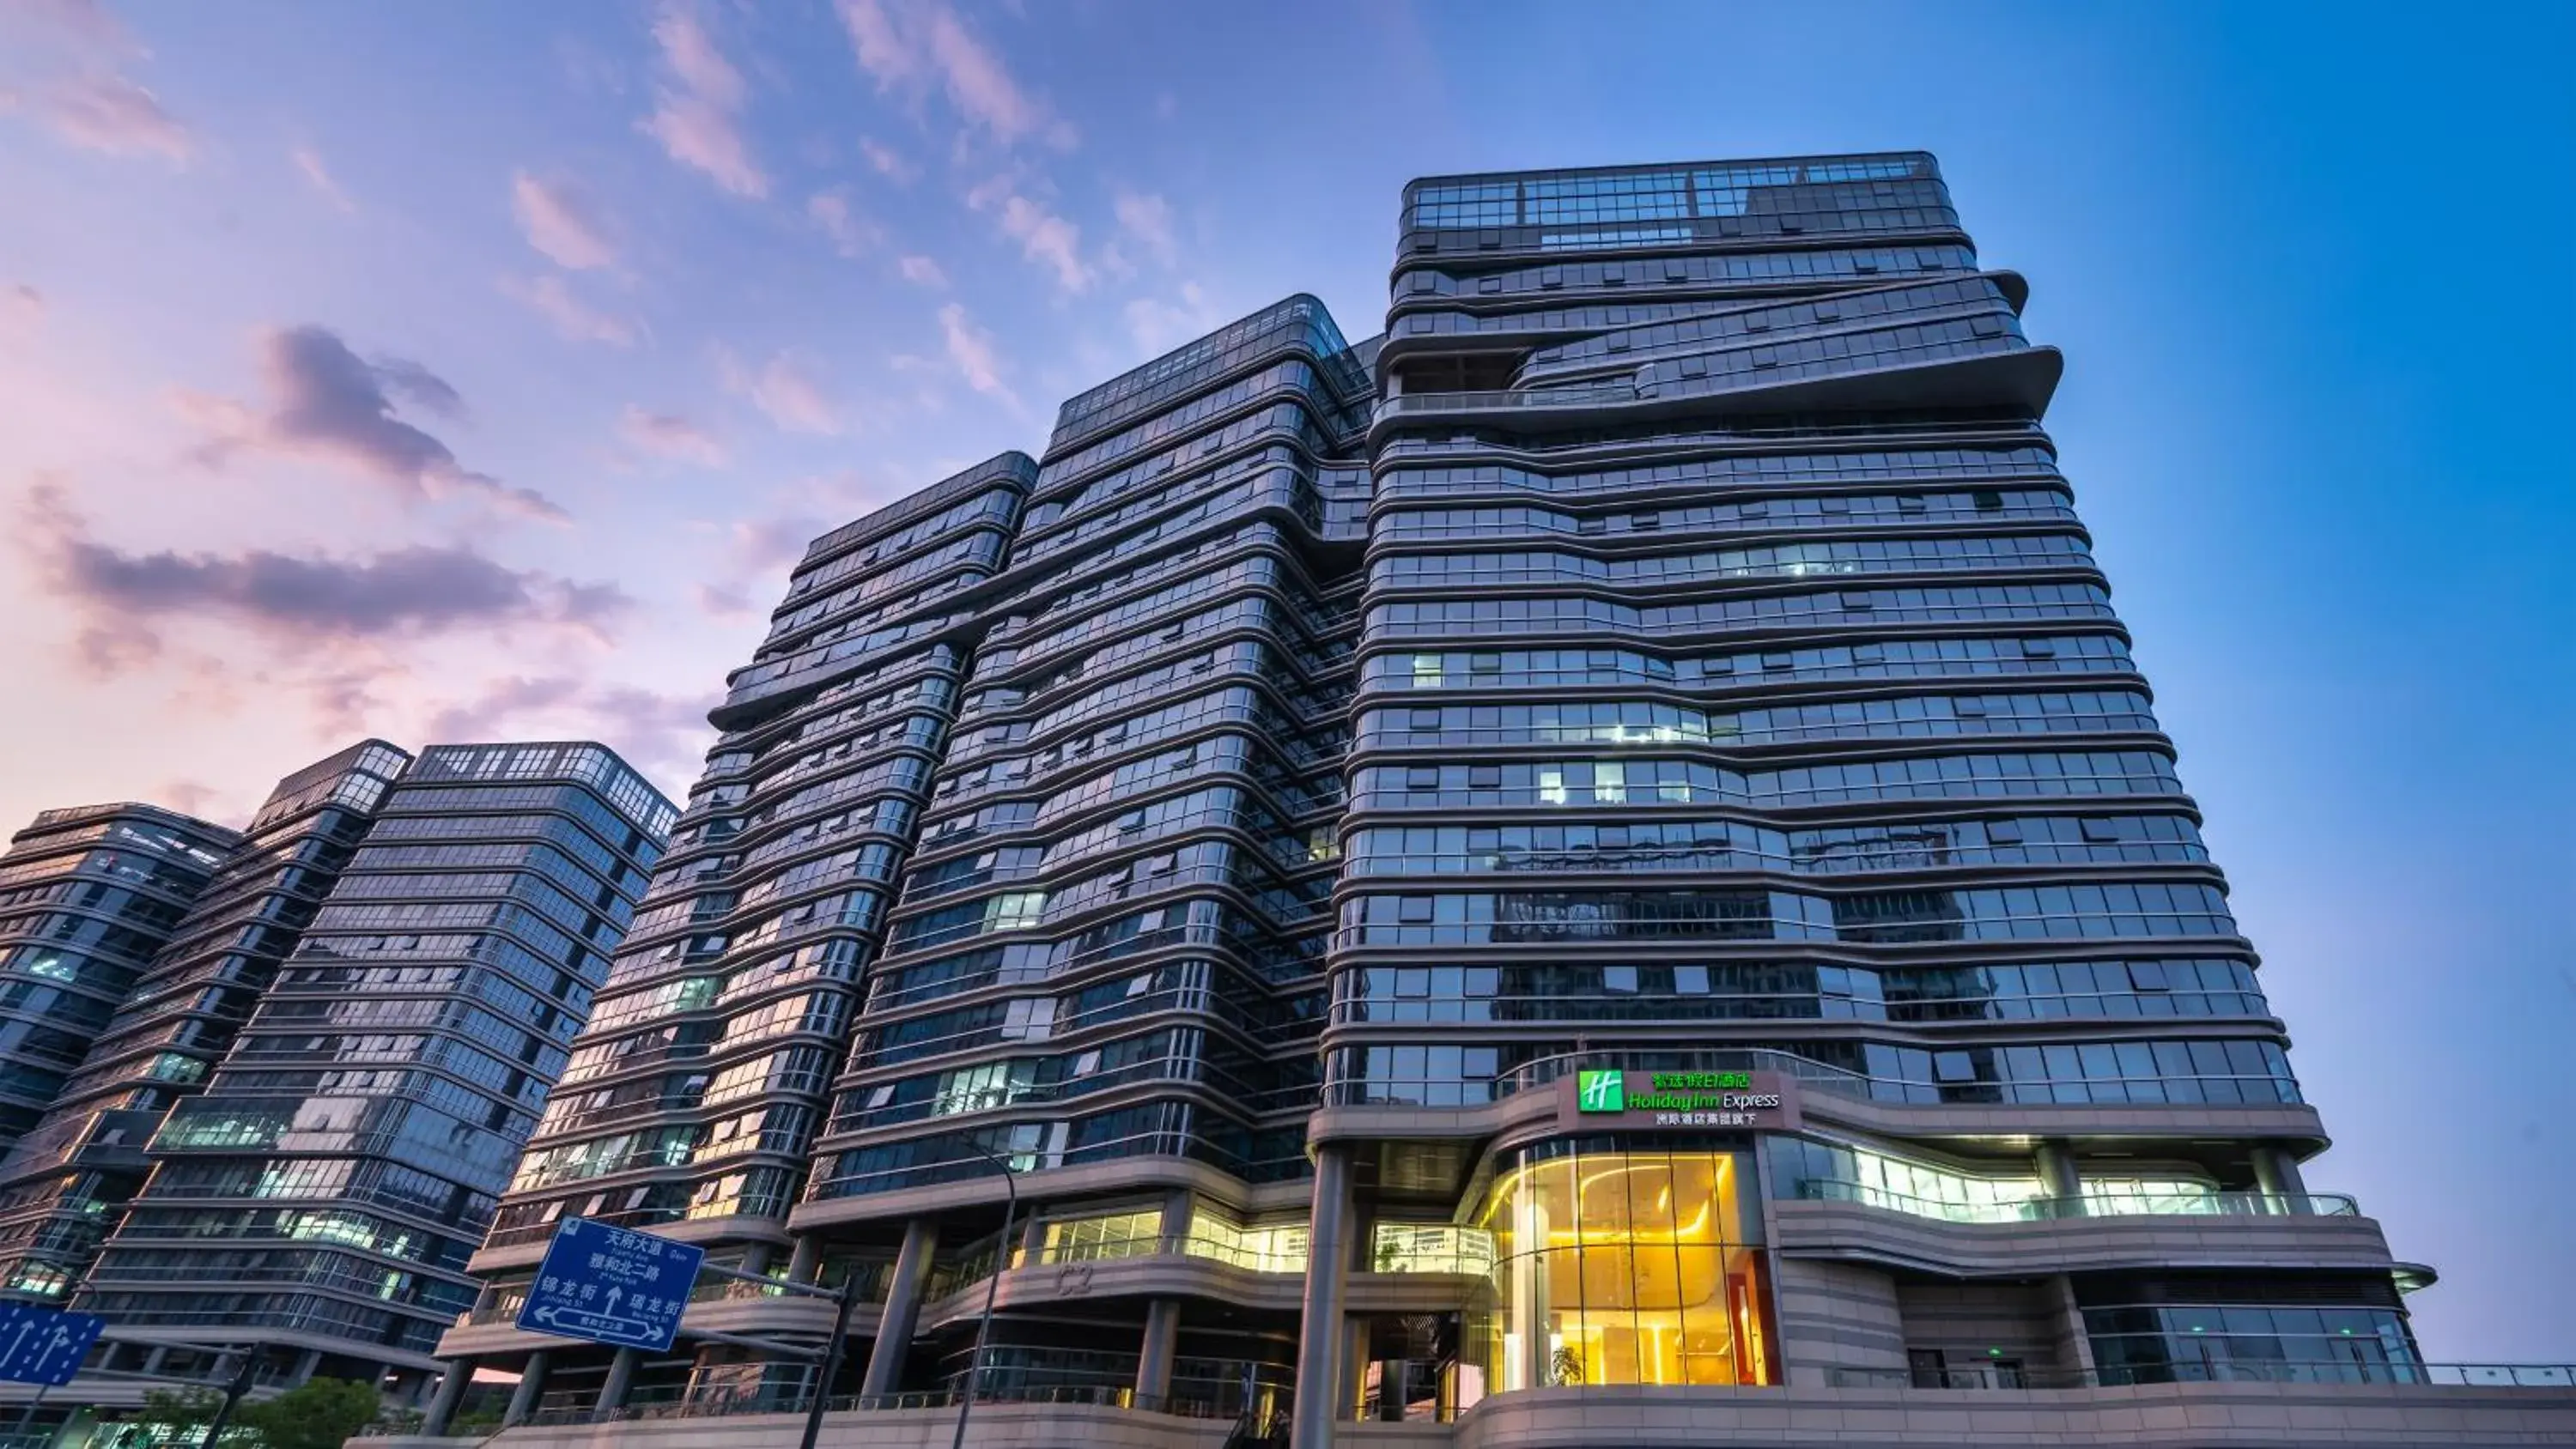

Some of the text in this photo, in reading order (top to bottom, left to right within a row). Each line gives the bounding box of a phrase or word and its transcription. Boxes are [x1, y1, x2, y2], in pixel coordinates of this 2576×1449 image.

[1628, 1091, 1778, 1112] Holiday Inn Express
[605, 1230, 663, 1256] 天府大道
